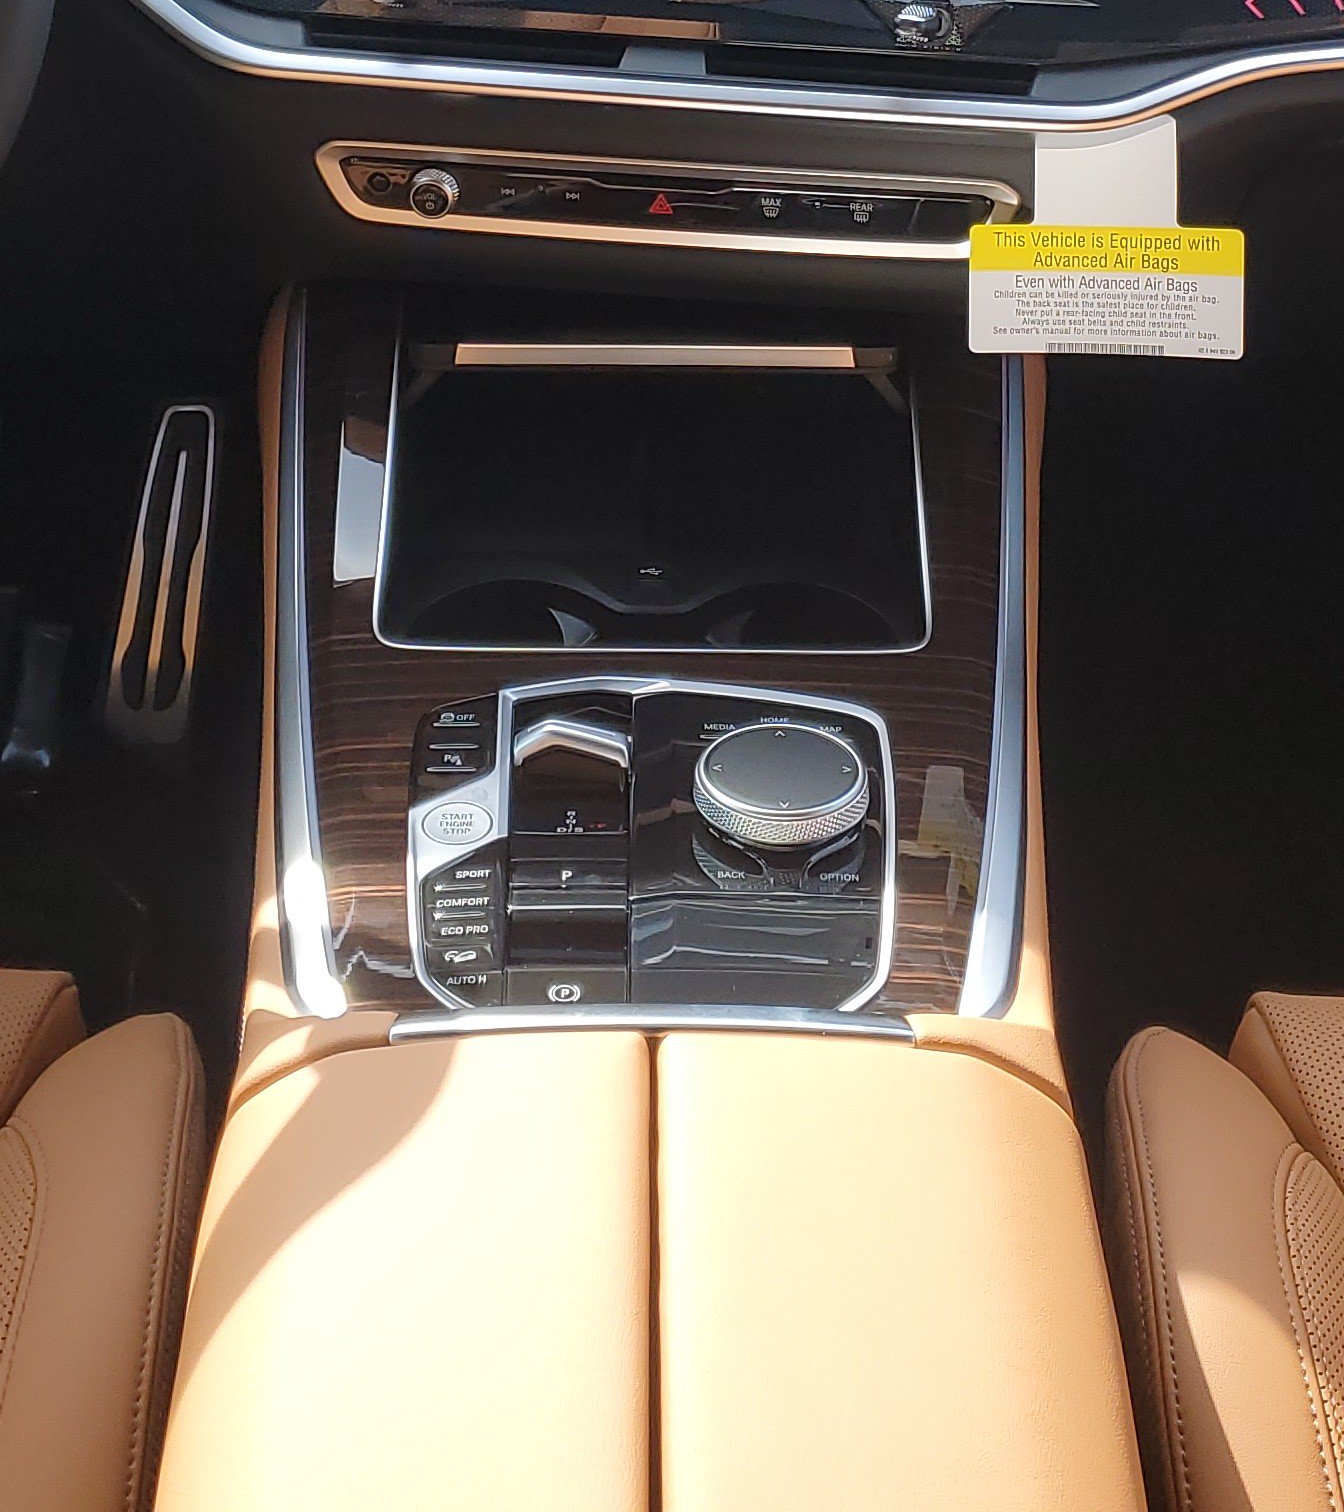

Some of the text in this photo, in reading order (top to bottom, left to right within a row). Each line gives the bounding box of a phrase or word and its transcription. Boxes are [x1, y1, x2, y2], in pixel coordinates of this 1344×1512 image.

[761, 197, 781, 207] MAX
[850, 202, 874, 212] REAR
[993, 231, 1220, 253] This Vehicle is Equipped with
[1033, 252, 1179, 272] Advanced Air Bags
[1015, 275, 1197, 294] Even with Advanced Air Bags
[994, 290, 1026, 298] Children
[1057, 291, 1078, 299] killed
[1092, 292, 1127, 301] seriously
[1130, 293, 1158, 301] injured
[1161, 294, 1170, 302] by
[1174, 294, 1185, 302] the
[1202, 295, 1220, 304] bag.
[1016, 299, 1030, 307] The
[1054, 300, 1070, 308] seat
[1097, 300, 1121, 309] safest
[1123, 302, 1144, 310] place
[1147, 302, 1158, 310] for
[1161, 303, 1196, 312] children.
[1015, 309, 1038, 317] Never
[1040, 309, 1053, 317] put
[1063, 309, 1106, 318] rear-facing
[1108, 310, 1127, 318] child
[1175, 312, 1196, 320] front.
[1022, 318, 1049, 326] Always
[1149, 321, 1189, 329] restraints.
[993, 326, 1007, 334] See
[1010, 327, 1039, 335] owner's
[1042, 327, 1071, 335] manual
[1074, 327, 1085, 335] for
[1110, 328, 1157, 337] information
[1159, 329, 1182, 337] about
[1197, 331, 1220, 341] bags.
[456, 869, 492, 879] SPORT
[561, 871, 573, 881] P
[717, 870, 745, 879] BACK
[820, 873, 860, 882] OPTION
[436, 897, 490, 907] COMFORT
[441, 925, 488, 935] ECO PRO
[447, 974, 487, 985] AUTO H
